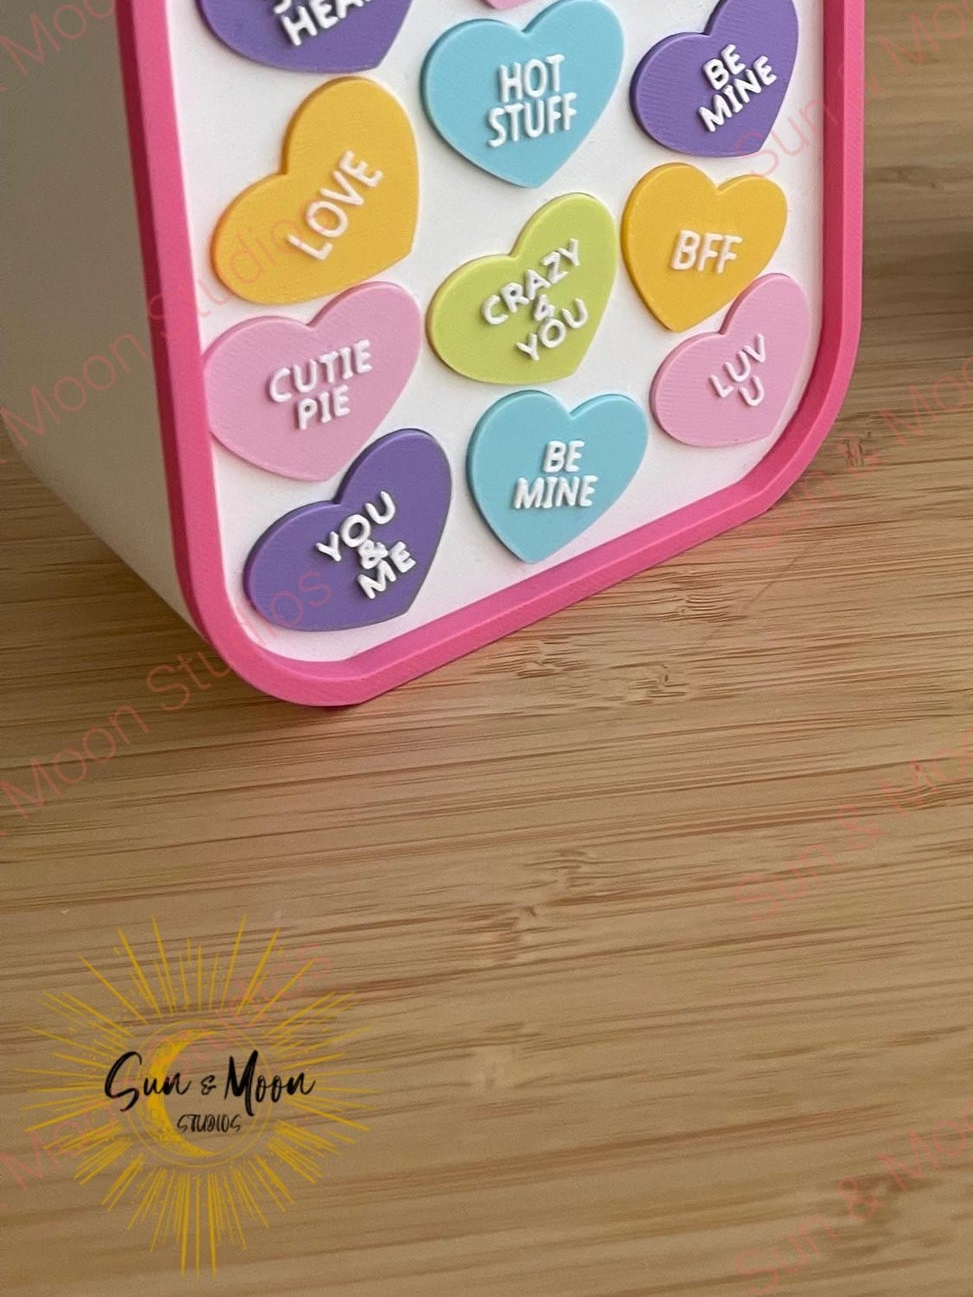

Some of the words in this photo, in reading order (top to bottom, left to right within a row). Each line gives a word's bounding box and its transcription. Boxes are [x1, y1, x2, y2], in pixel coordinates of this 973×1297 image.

[499, 53, 566, 104] HOT
[698, 55, 778, 133] MINE
[703, 44, 747, 91] BE
[487, 91, 577, 149] STUFF
[286, 150, 384, 261] LOVE
[671, 229, 743, 274] BFF
[481, 237, 582, 326] CRAZY
[533, 295, 556, 322] 4
[516, 298, 589, 362] YOU
[268, 339, 373, 403] CUTIE
[708, 333, 767, 399] LUV
[739, 375, 766, 407] U
[298, 385, 351, 431] PIE
[542, 439, 586, 473] BE
[514, 474, 599, 509] MINE
[316, 490, 397, 562] YOU
[357, 541, 417, 600] ME
[358, 538, 390, 570] &
